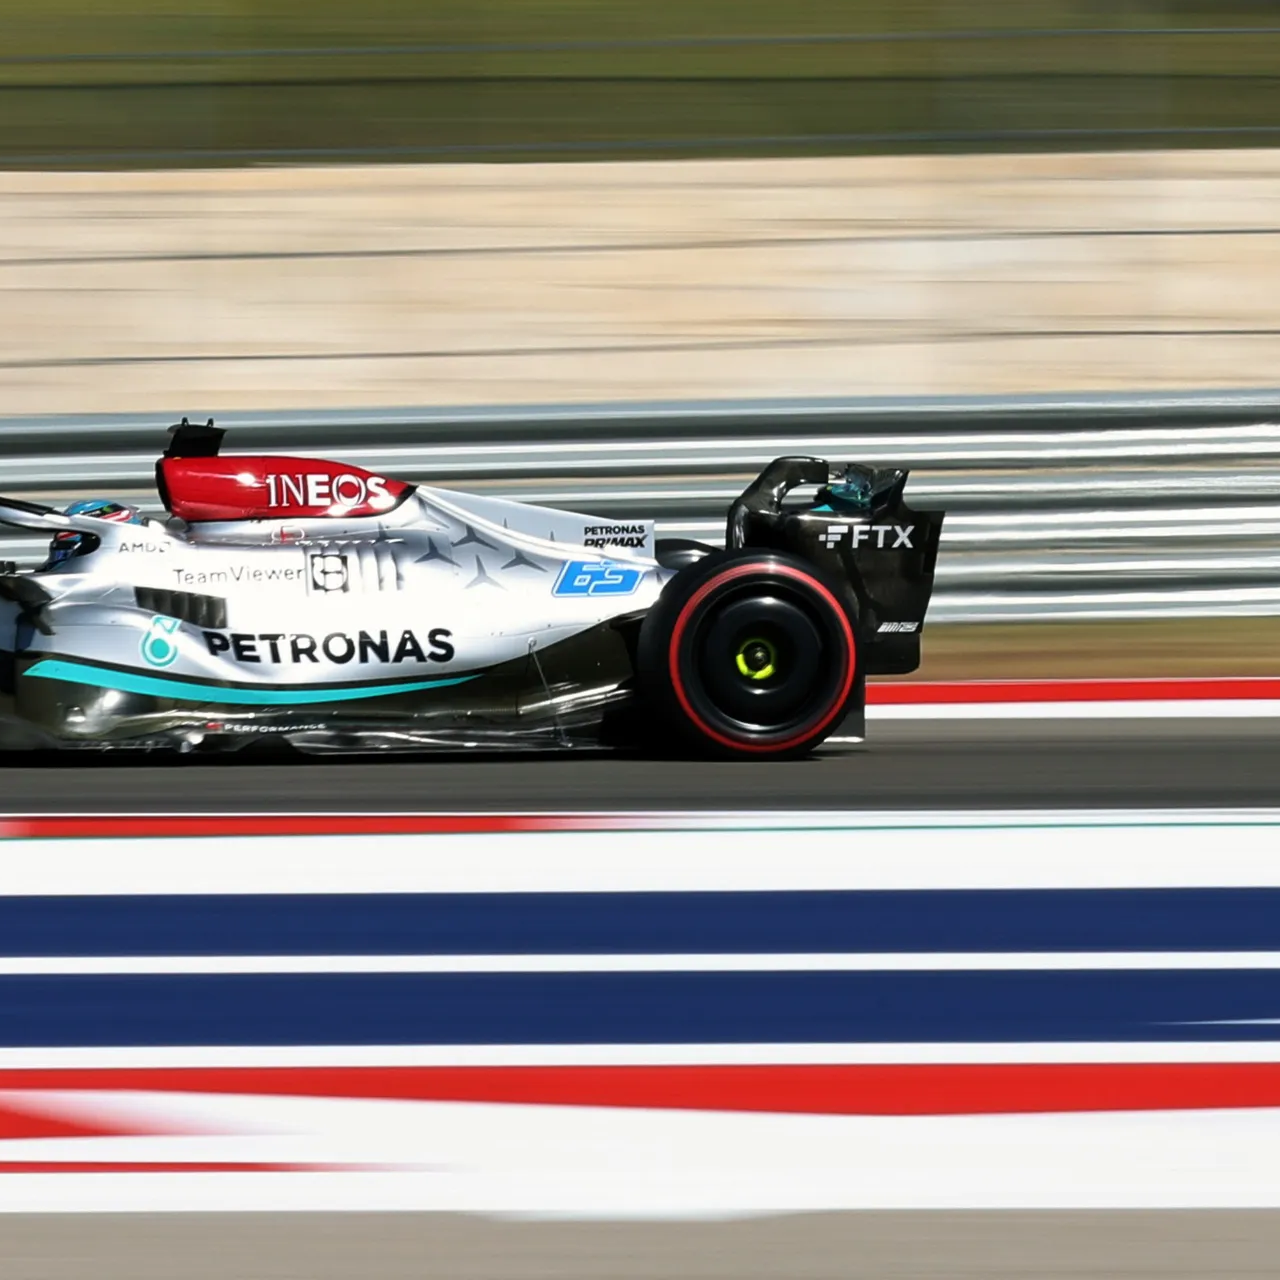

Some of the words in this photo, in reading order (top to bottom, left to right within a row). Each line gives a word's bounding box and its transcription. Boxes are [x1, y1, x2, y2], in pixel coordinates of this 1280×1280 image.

[266, 474, 397, 508] INEOS
[584, 525, 645, 535] PETRONAS
[852, 525, 915, 548] FTX
[173, 567, 305, 585] TeamViewer
[202, 628, 456, 665] PETRONAS
